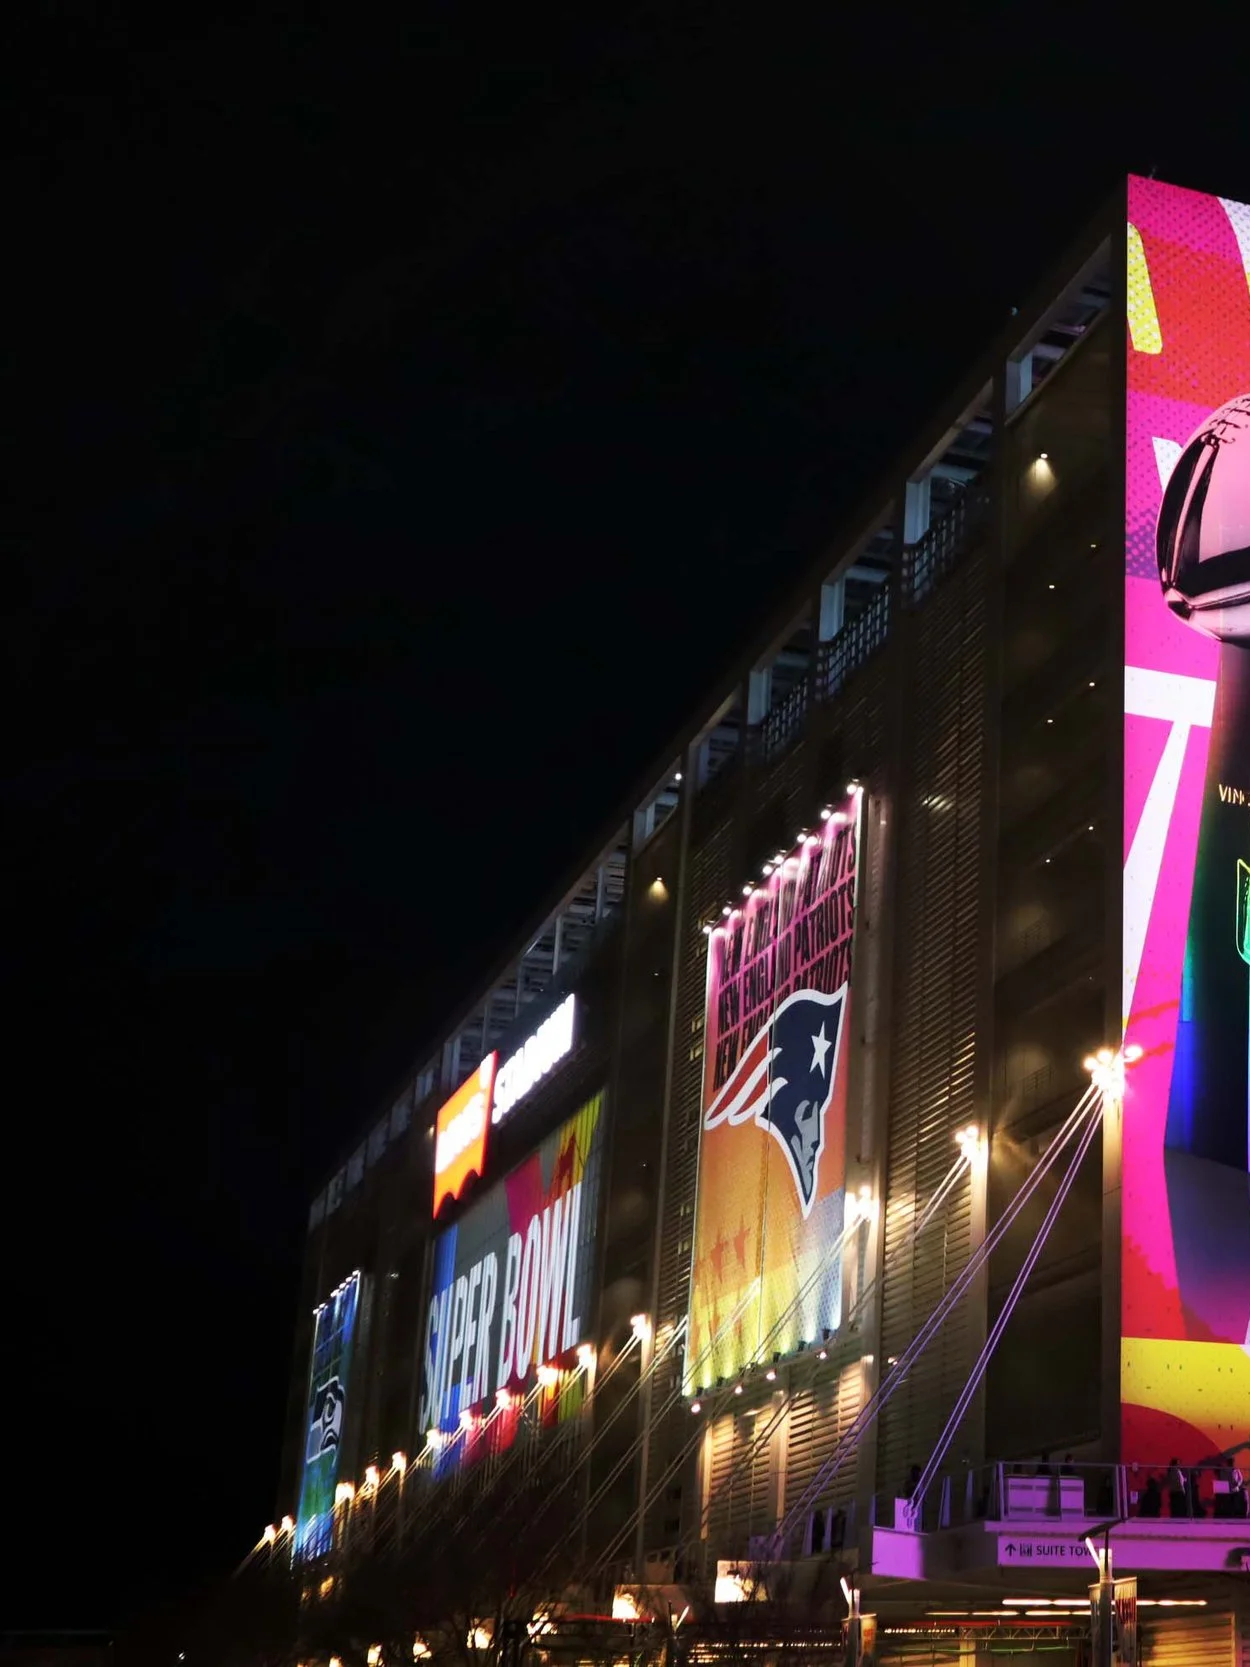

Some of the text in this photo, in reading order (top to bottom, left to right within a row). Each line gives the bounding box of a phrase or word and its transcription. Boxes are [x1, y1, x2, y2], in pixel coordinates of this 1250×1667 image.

[718, 877, 856, 1039] NEW ENGLAND PATRIOTS
[418, 1252, 497, 1434] SUPER
[497, 1182, 582, 1387] BOWL
[1036, 1545, 1065, 1556] SUITE
